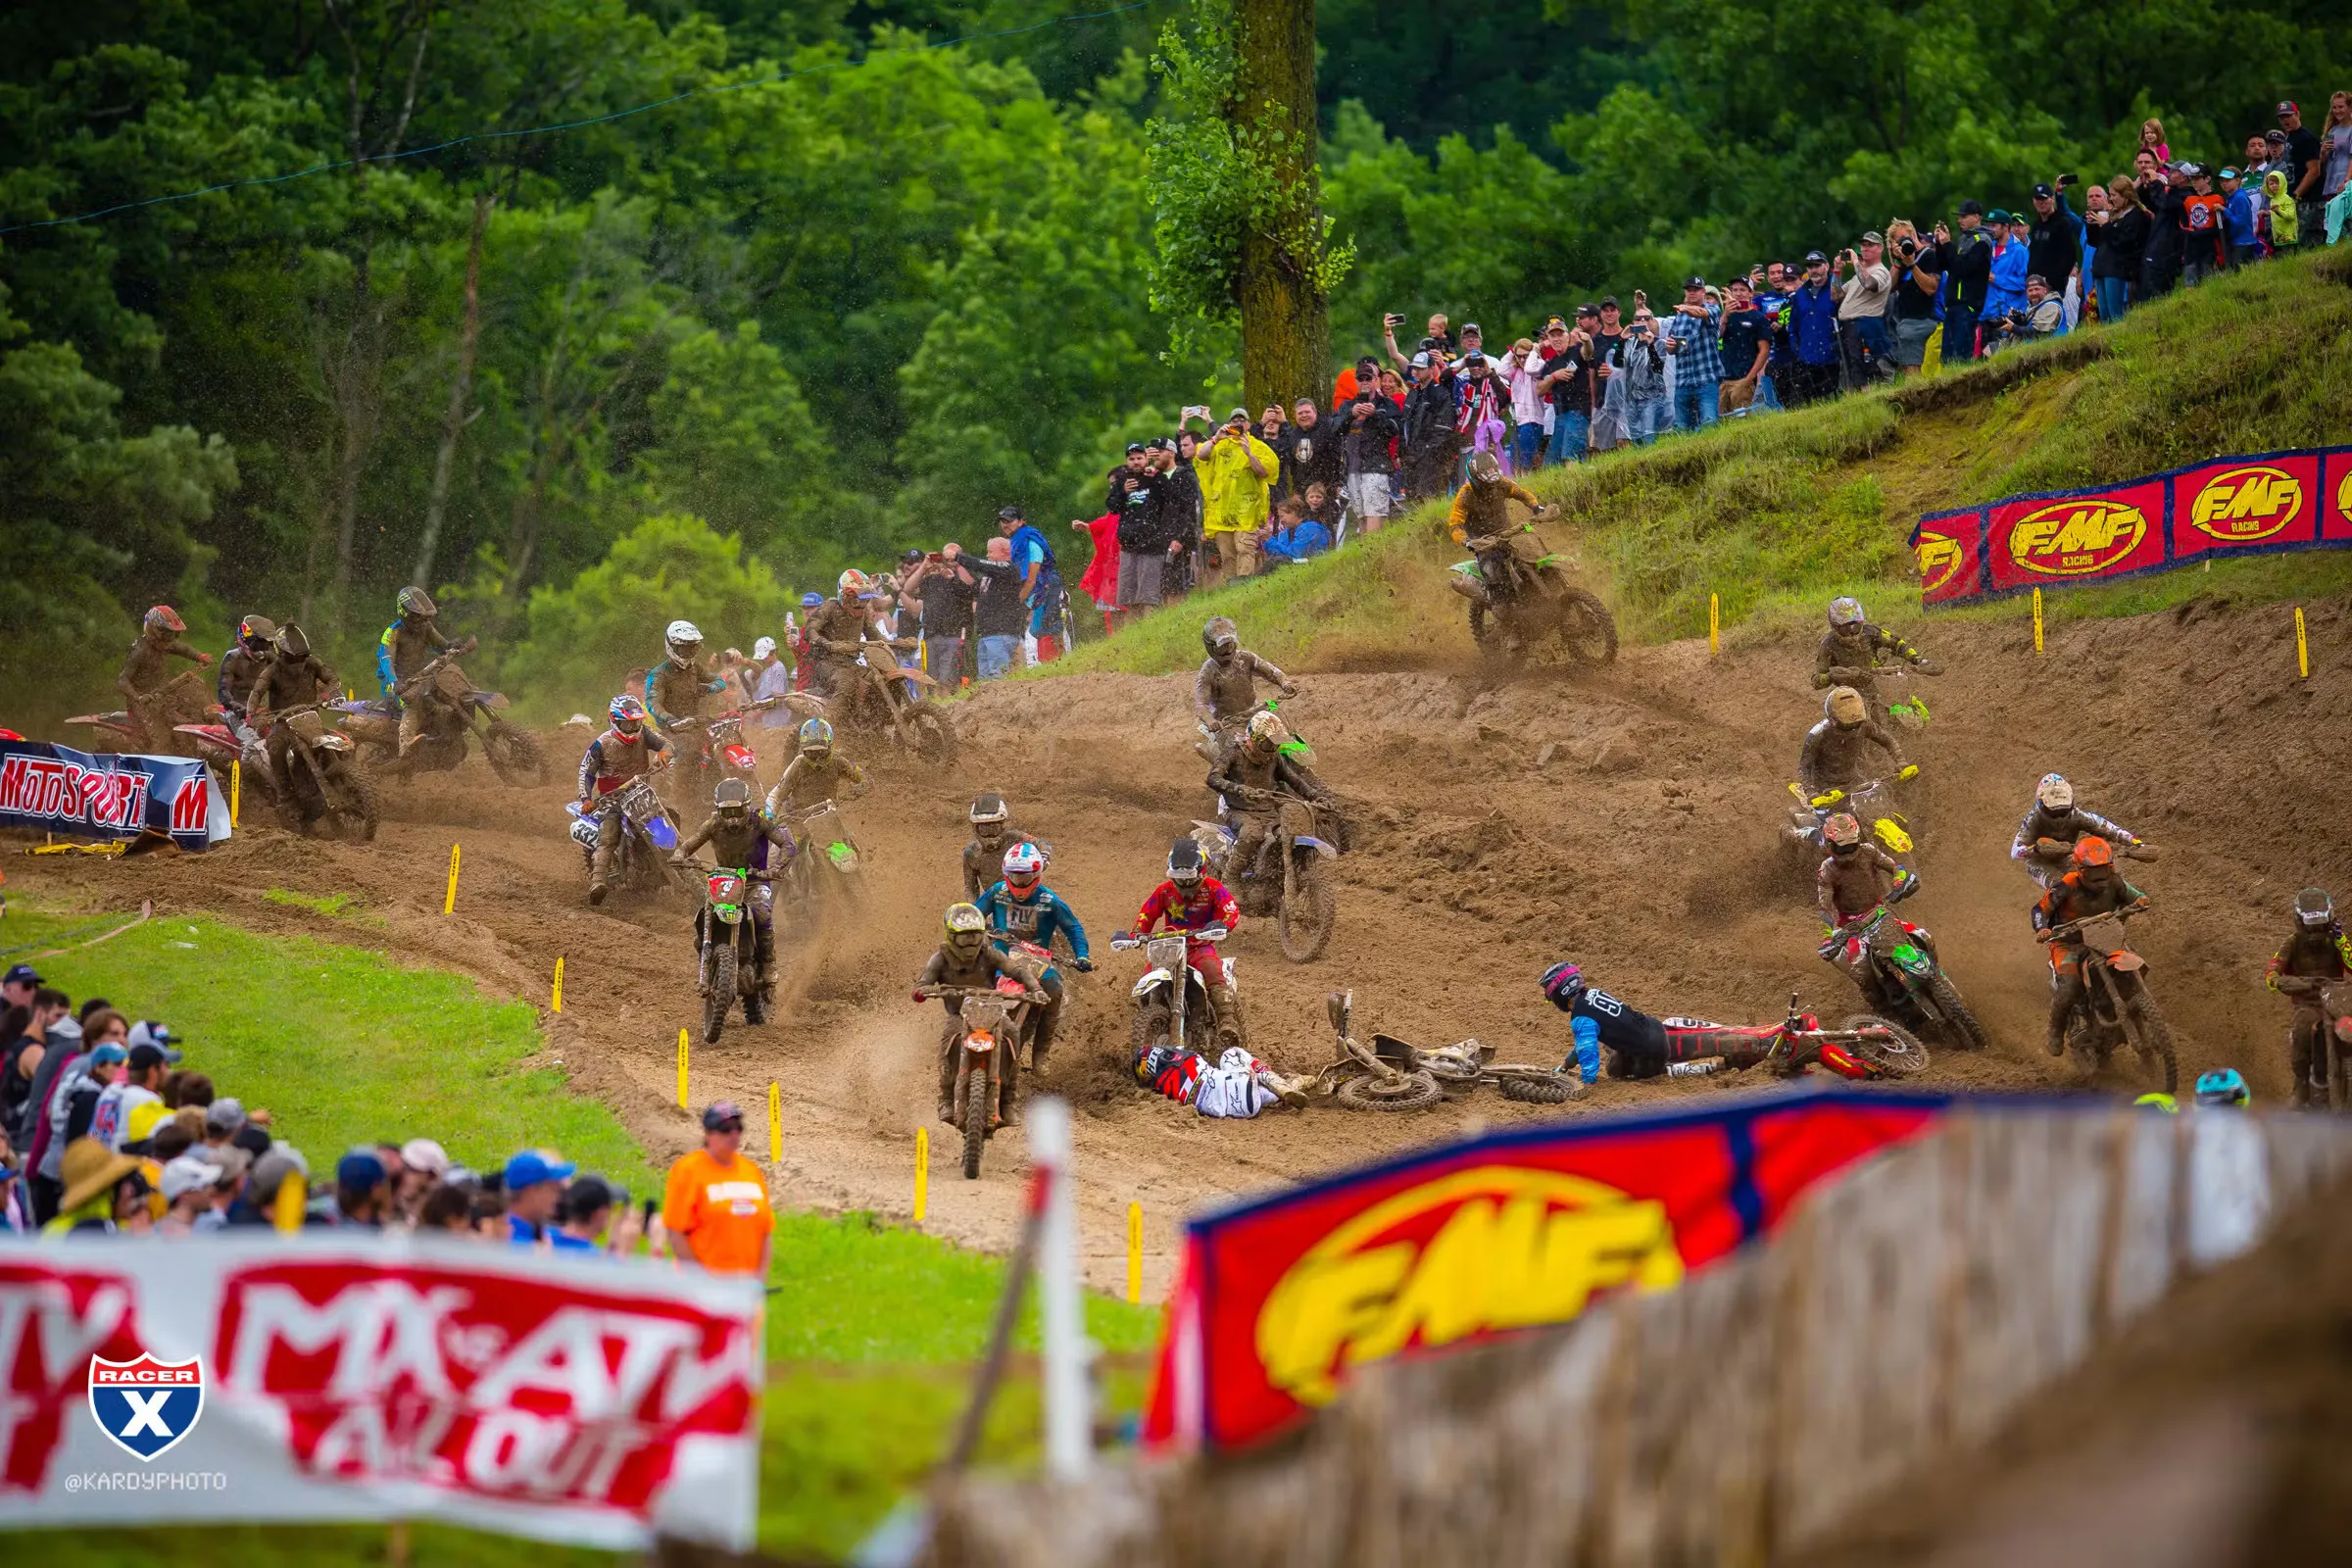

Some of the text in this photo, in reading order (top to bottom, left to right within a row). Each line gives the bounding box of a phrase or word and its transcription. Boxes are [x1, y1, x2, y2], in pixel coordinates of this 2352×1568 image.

[2192, 475, 2300, 521] FMF
[2012, 508, 2140, 559] FMF
[2230, 519, 2260, 532] RACING
[2062, 554, 2094, 567] RACING
[1260, 1198, 1669, 1388] FMF
